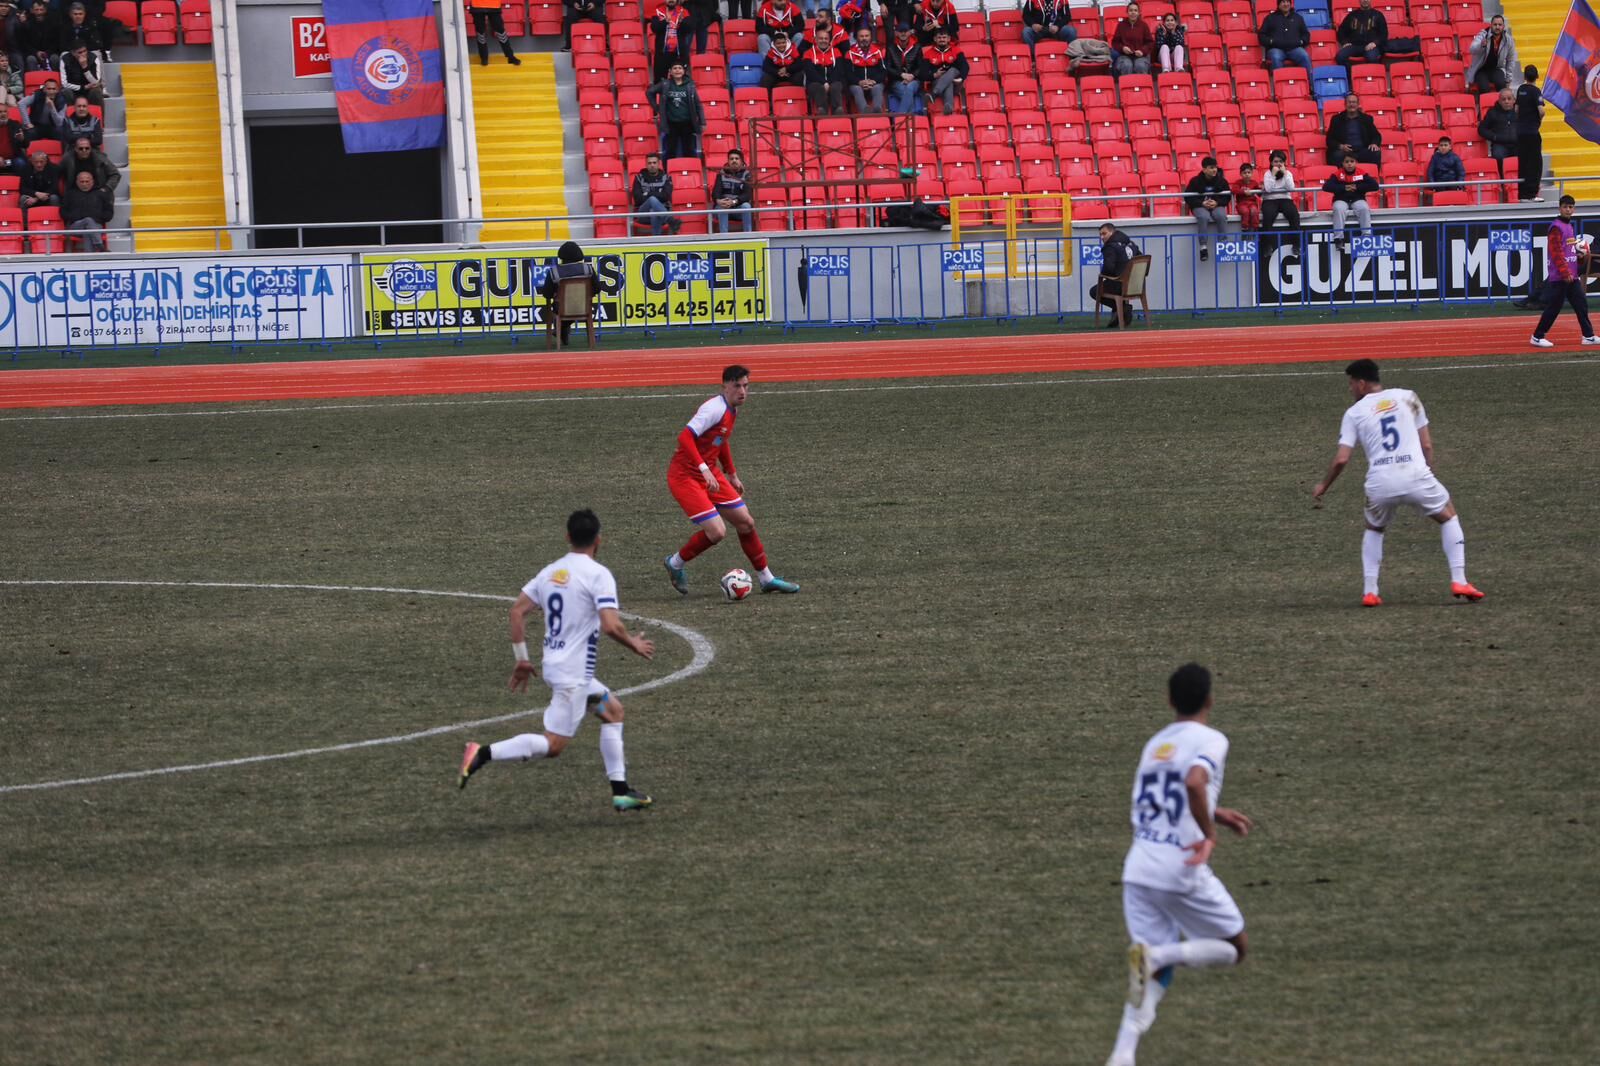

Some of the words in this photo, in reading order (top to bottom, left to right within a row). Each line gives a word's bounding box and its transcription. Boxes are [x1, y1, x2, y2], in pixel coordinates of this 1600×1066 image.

[300, 23, 325, 47] B2
[1269, 233, 1437, 294] GÜZEL
[96, 304, 178, 322] OĞUZHAN
[183, 301, 263, 320] DEMİRTAŞ
[462, 309, 475, 325] &
[482, 307, 543, 324] YEDEK
[625, 303, 668, 319] 0534
[675, 301, 708, 316] 425
[715, 300, 735, 315] 47
[744, 299, 765, 314] 10
[123, 328, 132, 336] 21
[165, 326, 195, 334] ZİRAAT
[197, 325, 225, 333] ODASI
[262, 323, 289, 331] NİĞDE
[1380, 415, 1399, 452] 5
[548, 592, 563, 637] 8
[1137, 771, 1184, 827] 55
